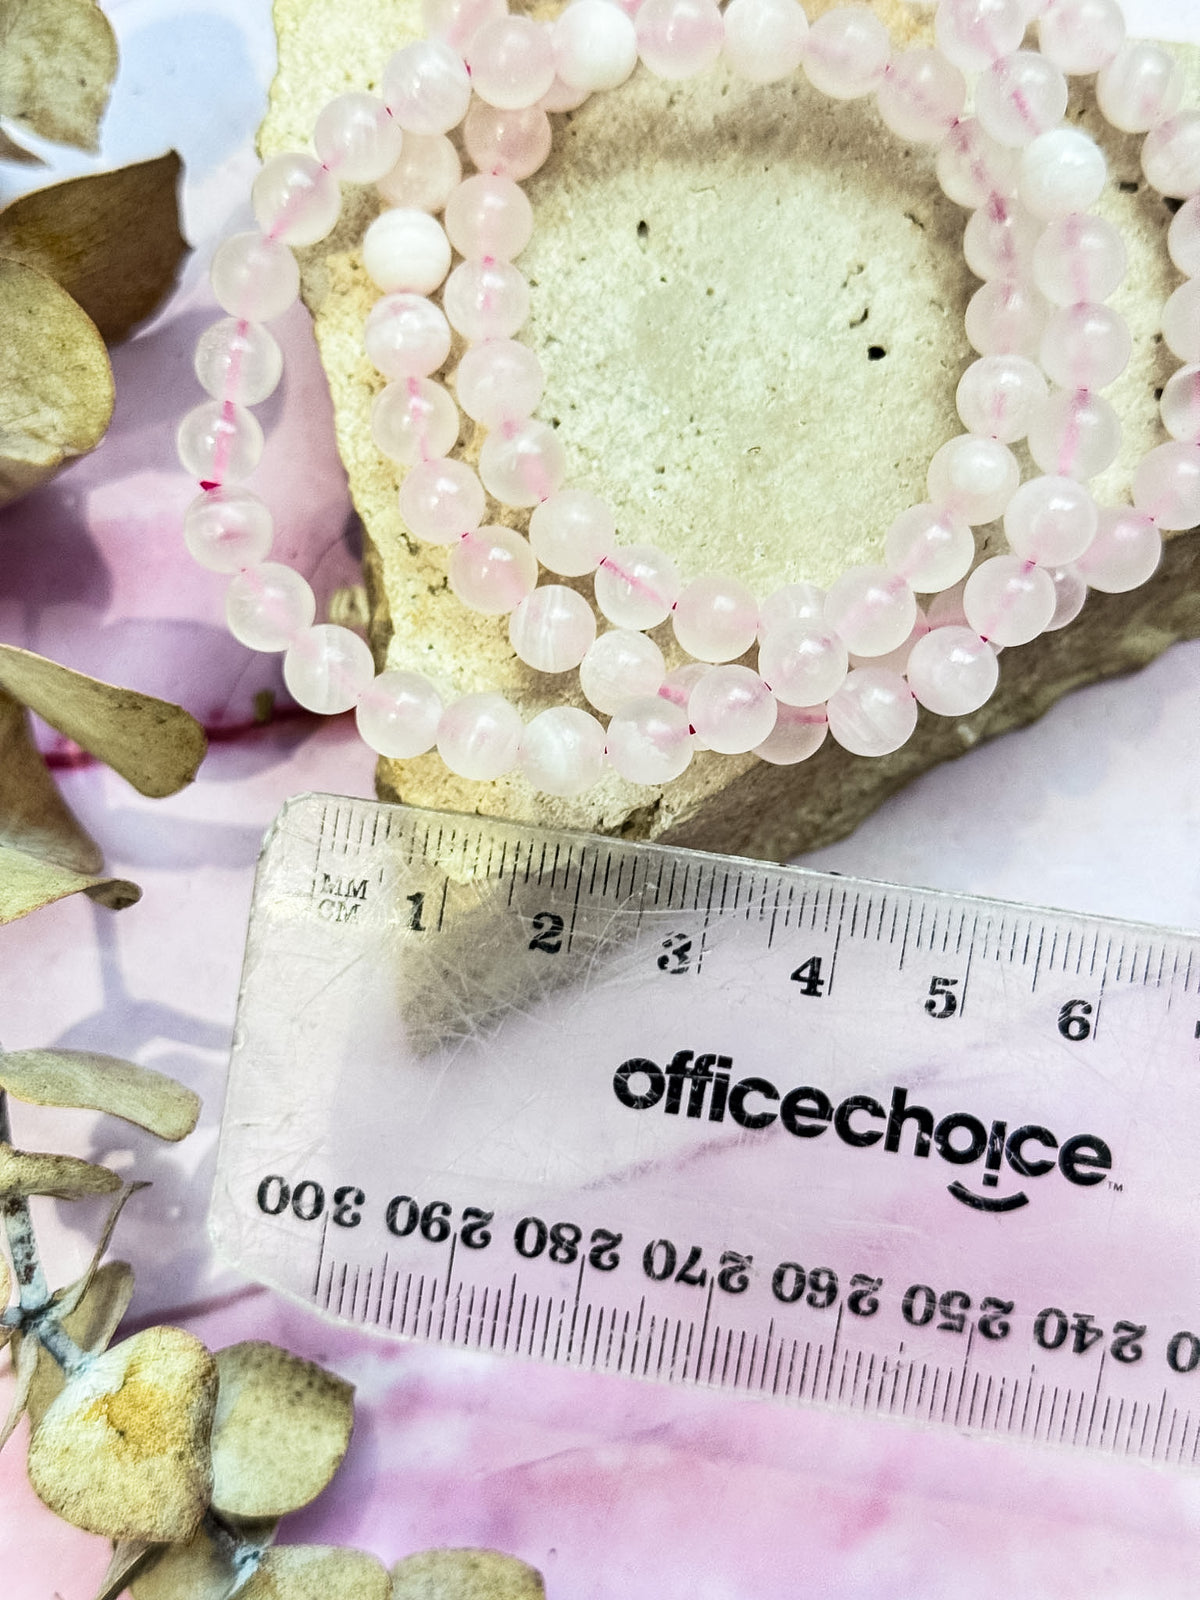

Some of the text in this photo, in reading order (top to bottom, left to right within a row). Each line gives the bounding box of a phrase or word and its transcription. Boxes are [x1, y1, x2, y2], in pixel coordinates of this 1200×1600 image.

[406, 891, 1093, 1041] 1 2 3 4 5 6
[256, 1174, 365, 1228] 300
[386, 1195, 494, 1250] 290
[514, 1216, 623, 1271] 280
[643, 1239, 753, 1294] 270
[772, 1261, 883, 1317] 260
[901, 1284, 1014, 1340] 250
[1033, 1307, 1147, 1363] 240
